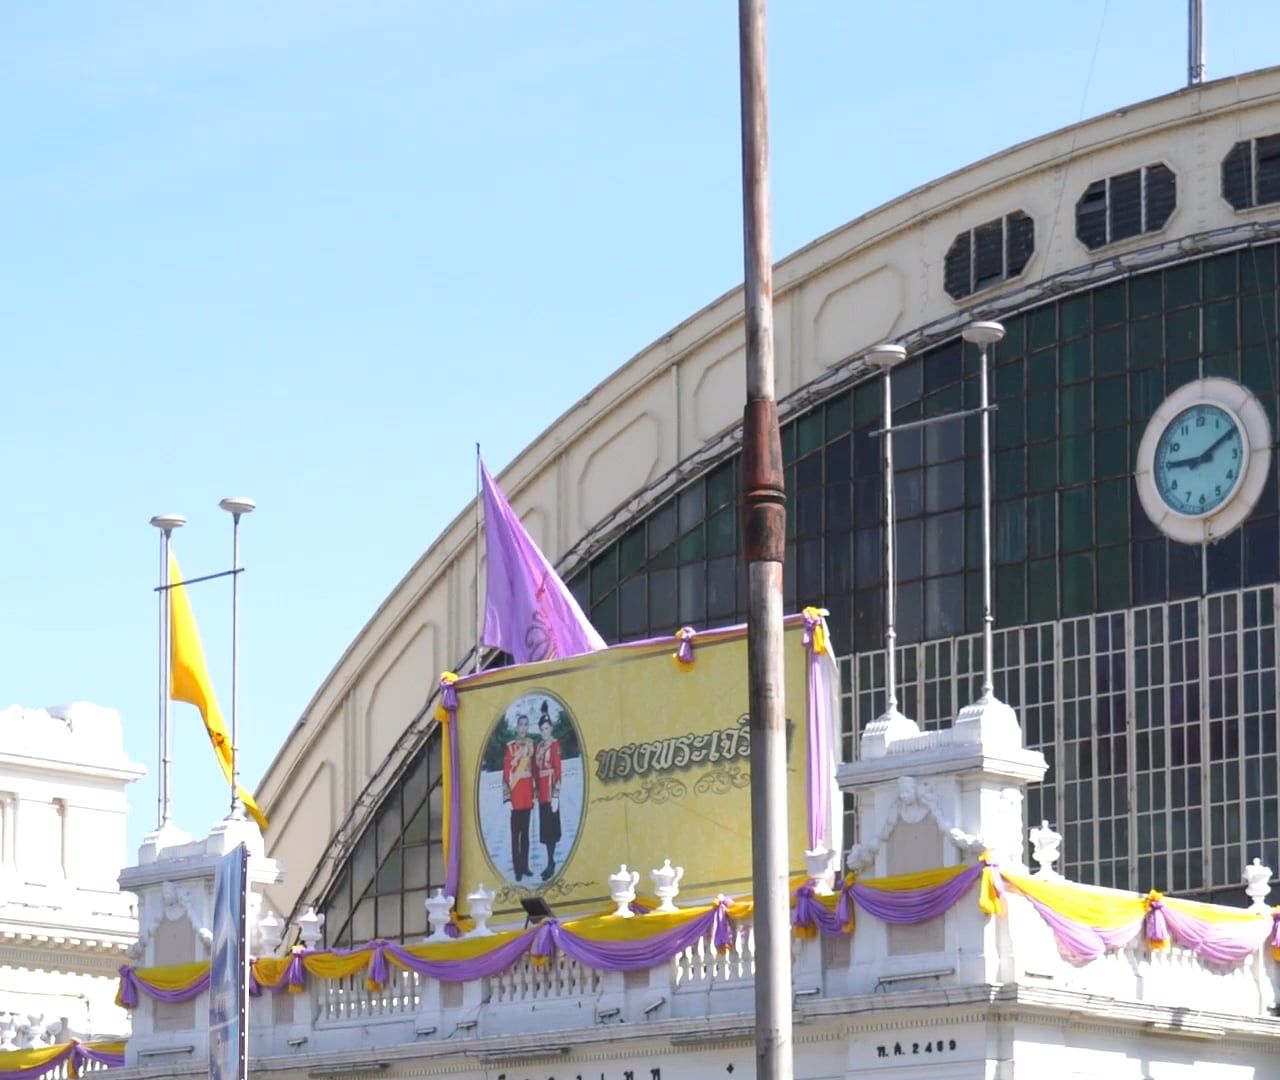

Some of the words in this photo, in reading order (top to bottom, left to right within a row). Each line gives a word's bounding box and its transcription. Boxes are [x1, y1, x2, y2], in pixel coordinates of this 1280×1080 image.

[1195, 416, 1206, 428] 12
[1181, 425, 1189, 436] 11
[1169, 442, 1180, 453] 10
